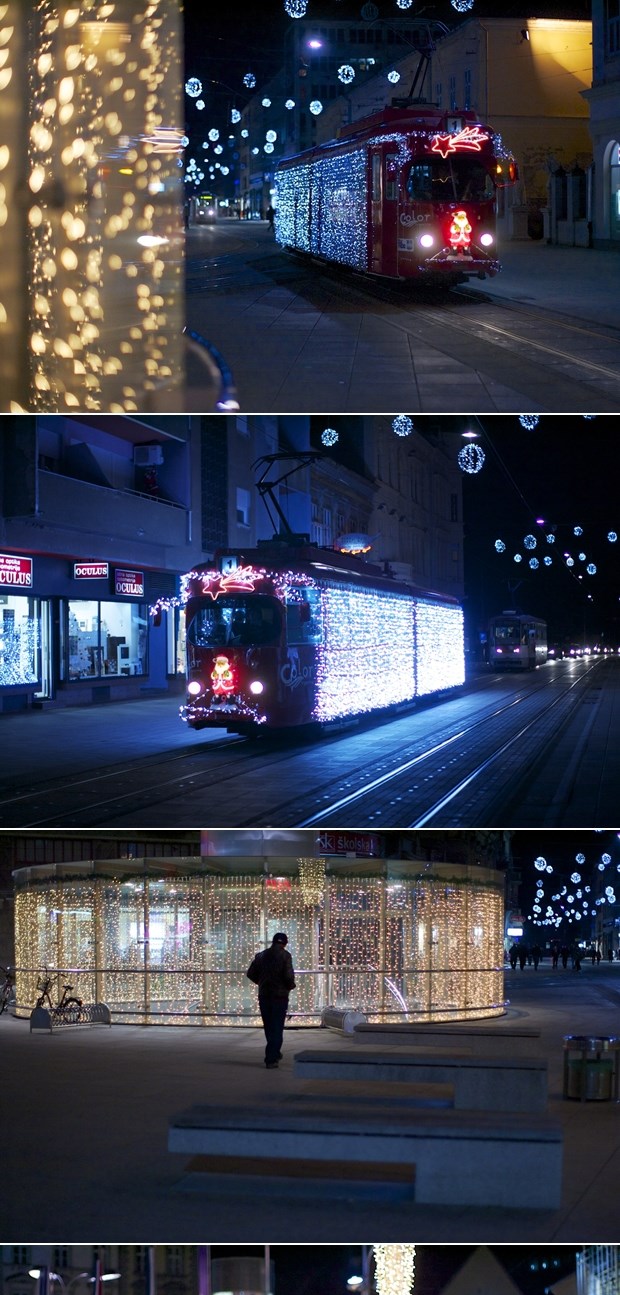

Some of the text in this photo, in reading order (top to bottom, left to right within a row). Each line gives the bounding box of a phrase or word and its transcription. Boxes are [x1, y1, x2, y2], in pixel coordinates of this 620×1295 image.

[452, 120, 457, 131] 1
[227, 559, 233, 569] 1
[75, 567, 107, 576] OCULUS
[0, 570, 31, 585] CULUS
[116, 582, 144, 594] OCULUS
